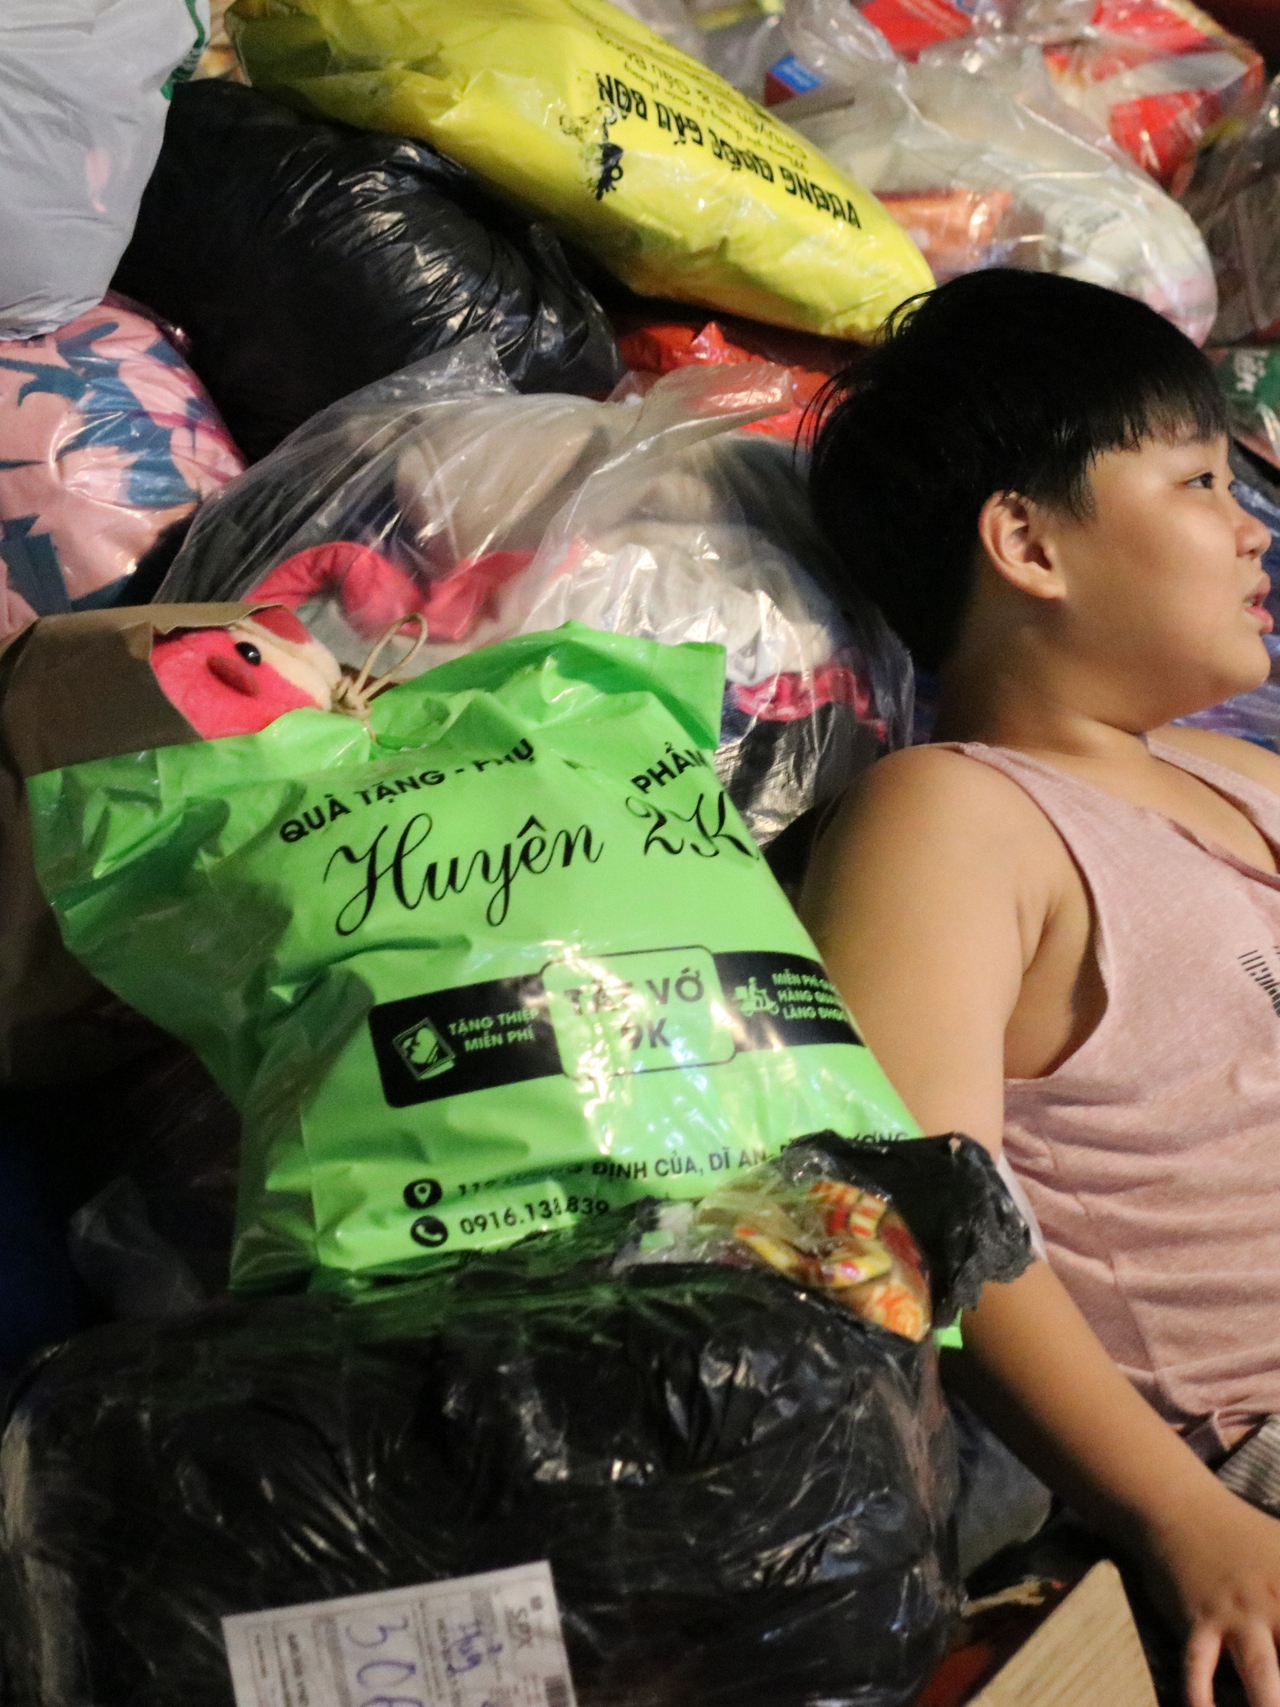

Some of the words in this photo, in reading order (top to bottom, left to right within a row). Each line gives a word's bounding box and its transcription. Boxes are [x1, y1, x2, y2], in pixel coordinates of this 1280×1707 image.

[654, 100, 705, 147] GẤU
[707, 127, 775, 183] QUỐC
[779, 165, 862, 229] VƯƠNG
[279, 793, 352, 844] QUÀ
[354, 769, 447, 805] TẶNG
[322, 811, 605, 937] Huyên
[625, 790, 761, 863] 2K
[645, 966, 705, 1006] VỚ
[448, 1014, 495, 1036] TẶNG
[463, 1030, 504, 1053] MIỄN
[506, 1024, 536, 1045] PHÍ
[710, 1145, 731, 1172] DĨ
